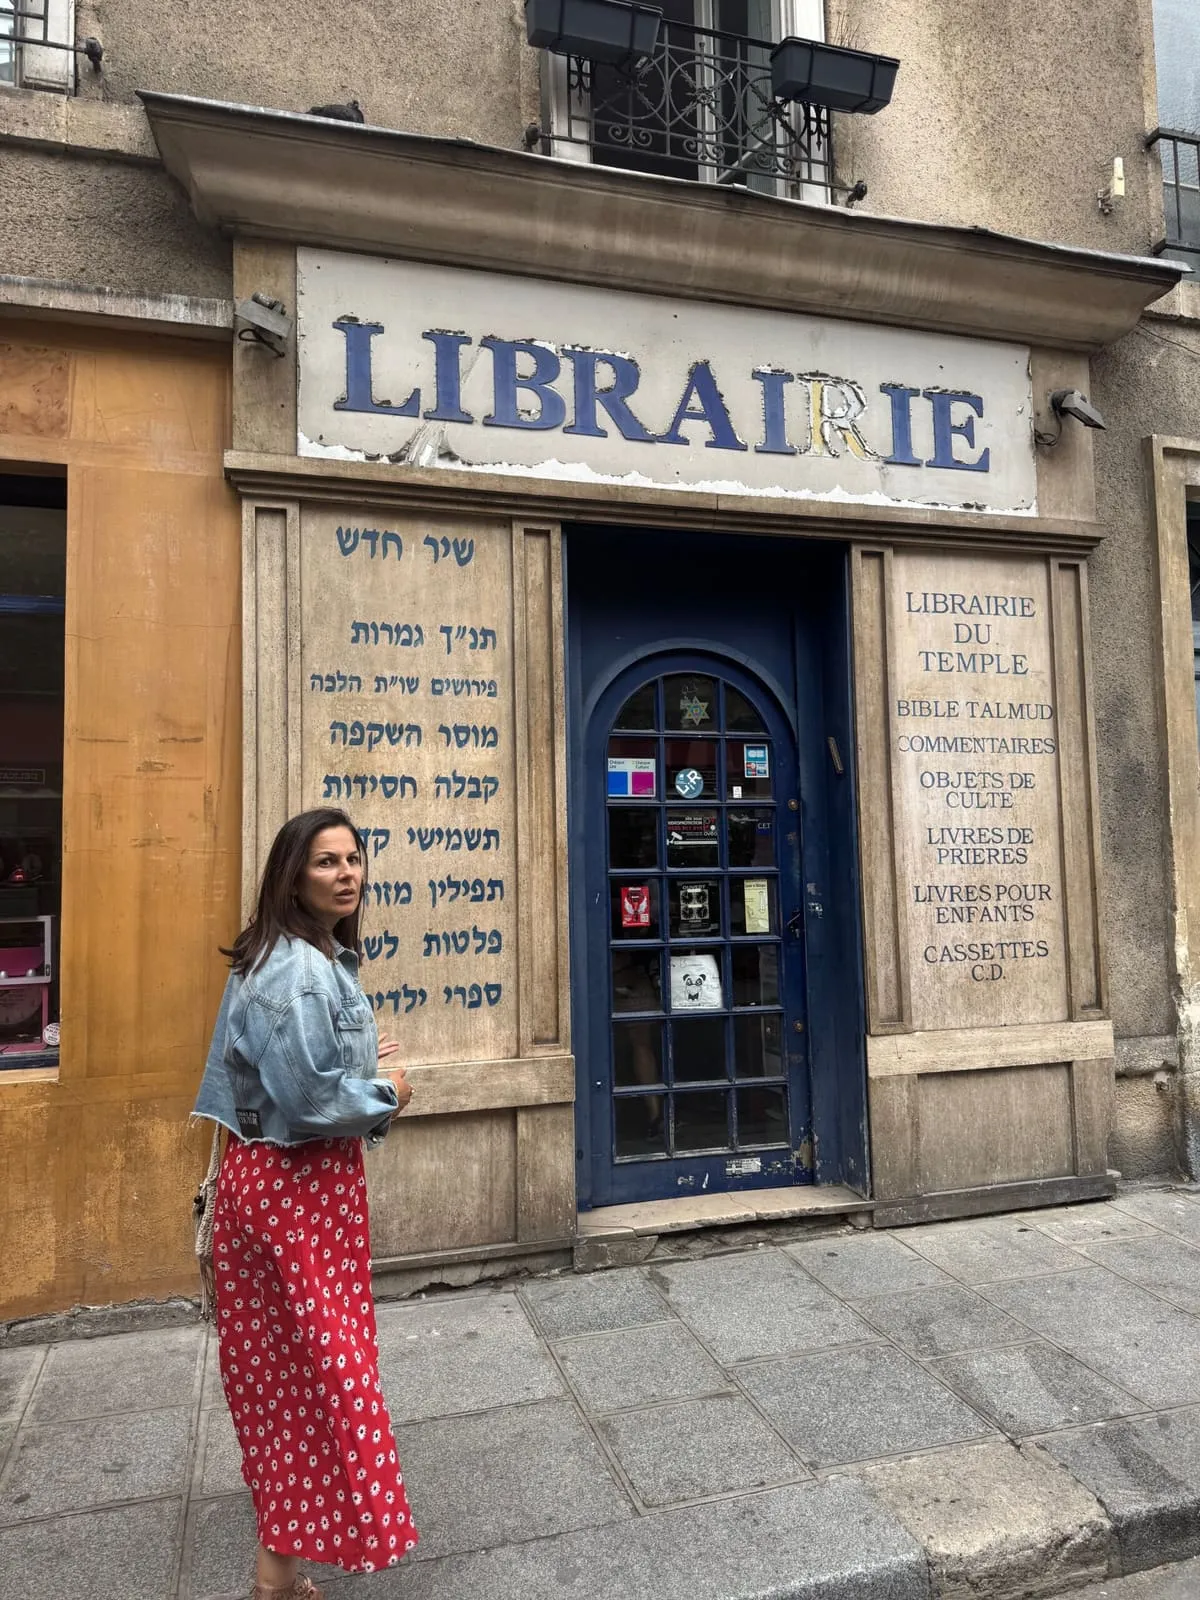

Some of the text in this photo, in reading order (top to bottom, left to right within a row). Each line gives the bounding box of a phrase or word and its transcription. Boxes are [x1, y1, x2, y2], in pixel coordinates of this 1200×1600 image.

[332, 319, 991, 472] LIBRAIRIE
[336, 526, 475, 567] שיר חדש
[905, 591, 1036, 618] LIBRAIRIE
[351, 620, 425, 648] גמרות
[954, 623, 992, 645] DU
[919, 651, 1029, 675] TEMPLE
[310, 670, 362, 693] הלכה
[430, 678, 498, 698] פירושים
[897, 699, 1053, 720] BIBLE TALMUD
[330, 720, 499, 753] מוסר השקפה
[898, 735, 1057, 755] COMMENTAIRES
[322, 769, 500, 804] קבלה חסידות
[919, 771, 1036, 789] OBJETS DE
[946, 791, 1014, 809] CULTE
[358, 827, 501, 858] תשמישי קד
[927, 827, 1034, 845] LIVRES DE
[936, 848, 1028, 865] PRIERES
[365, 874, 505, 908] תפילין מזוז
[914, 884, 1052, 903] LIVRES POUR
[935, 904, 1034, 924] ENFANTS
[363, 925, 503, 960] פלטות לש
[923, 940, 1049, 964] CASSETTES
[971, 964, 1006, 982] C.D.
[442, 981, 503, 1009] ספרי
